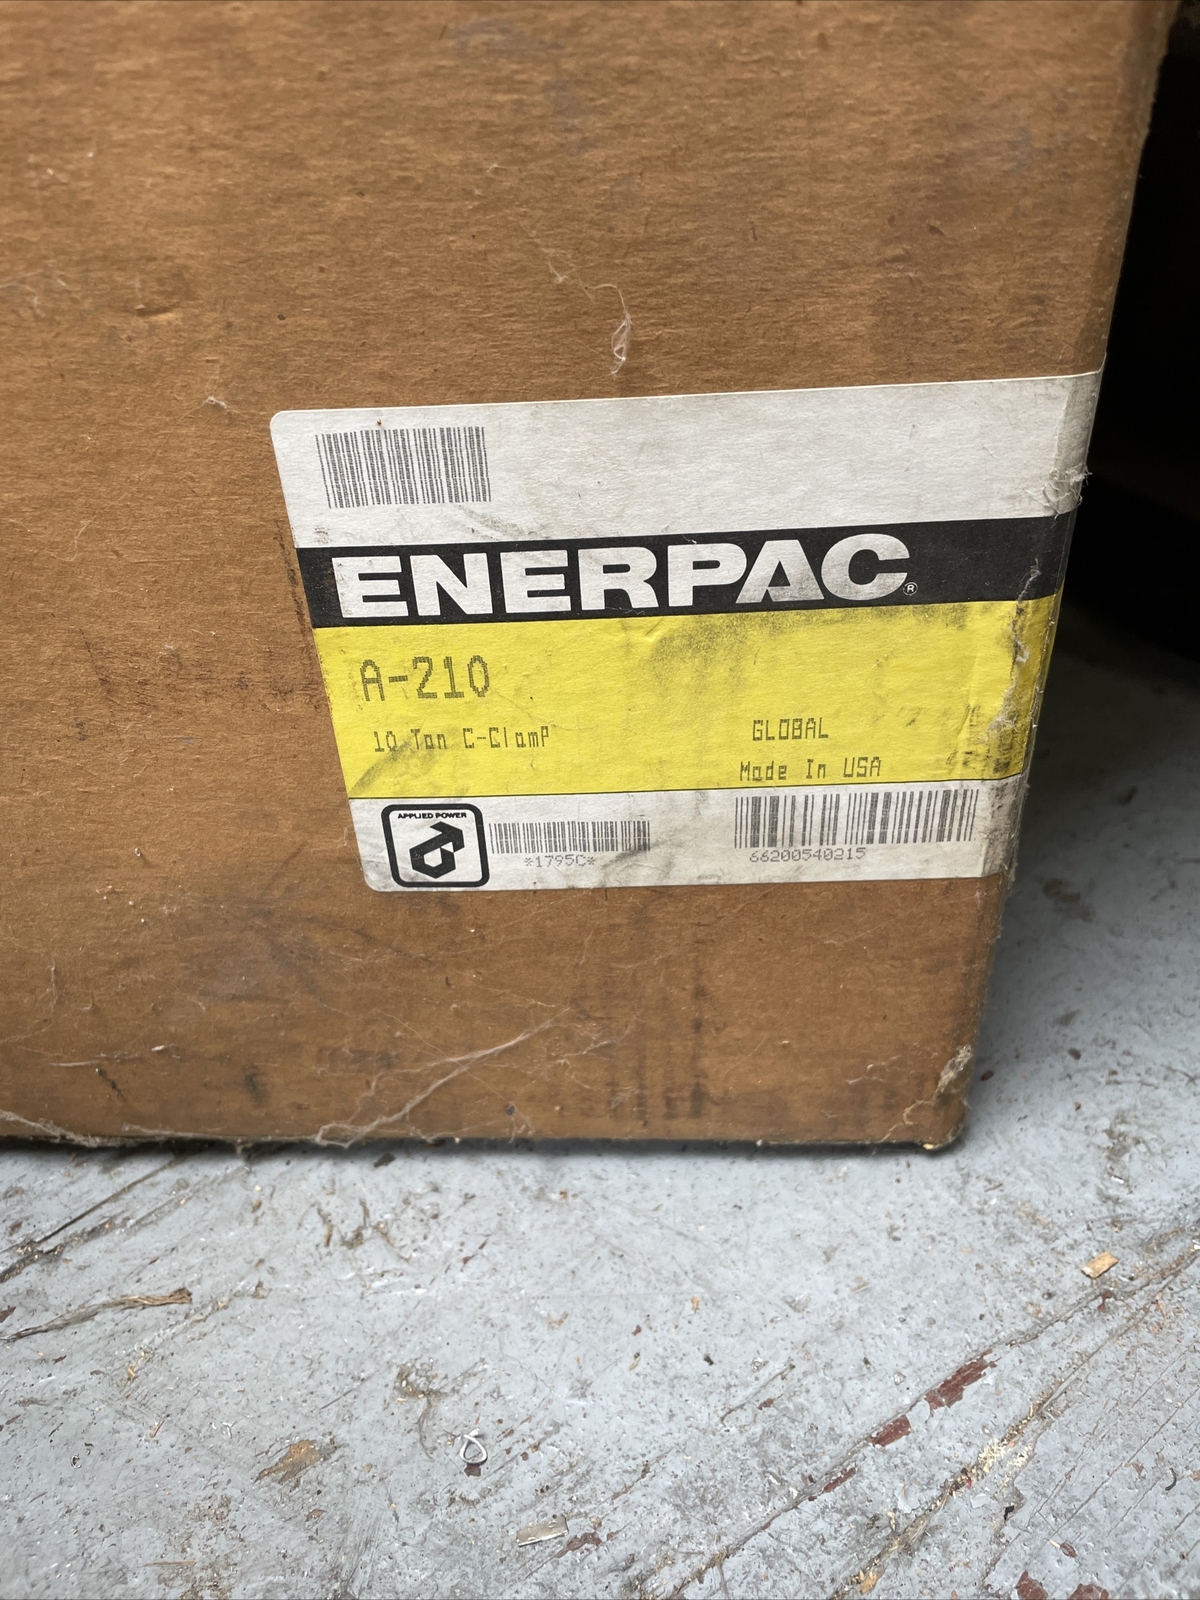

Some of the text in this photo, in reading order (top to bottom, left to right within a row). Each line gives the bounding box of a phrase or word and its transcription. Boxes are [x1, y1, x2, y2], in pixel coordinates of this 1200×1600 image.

[359, 654, 491, 702] A-210
[373, 730, 398, 753] 10
[410, 728, 447, 751] Ton
[752, 717, 829, 741] GLOBAL
[739, 756, 881, 781] Made In USA
[749, 847, 867, 863] 66200540215
